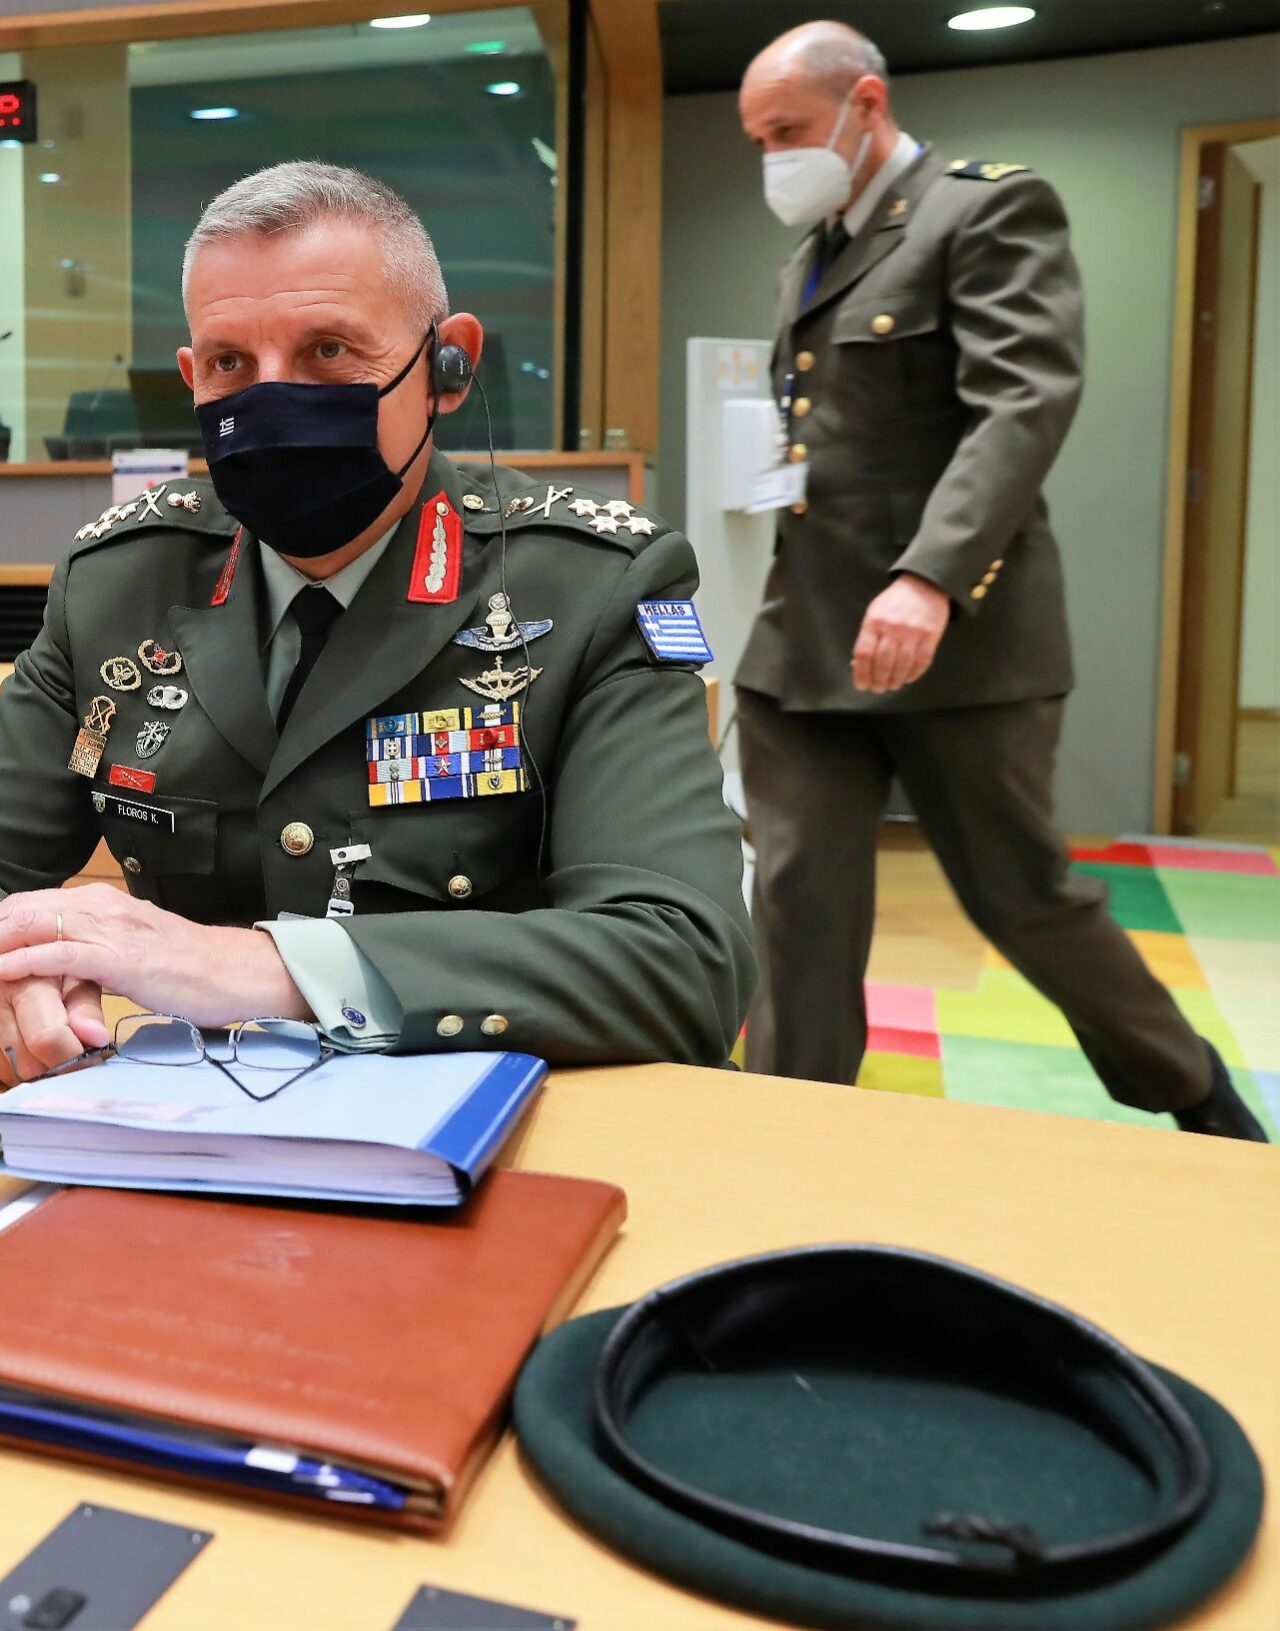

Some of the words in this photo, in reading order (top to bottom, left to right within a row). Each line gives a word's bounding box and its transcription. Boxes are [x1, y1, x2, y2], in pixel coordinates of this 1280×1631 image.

[643, 604, 686, 616] HELLAS
[118, 804, 148, 821] FLOROS
[151, 813, 159, 824] K.
